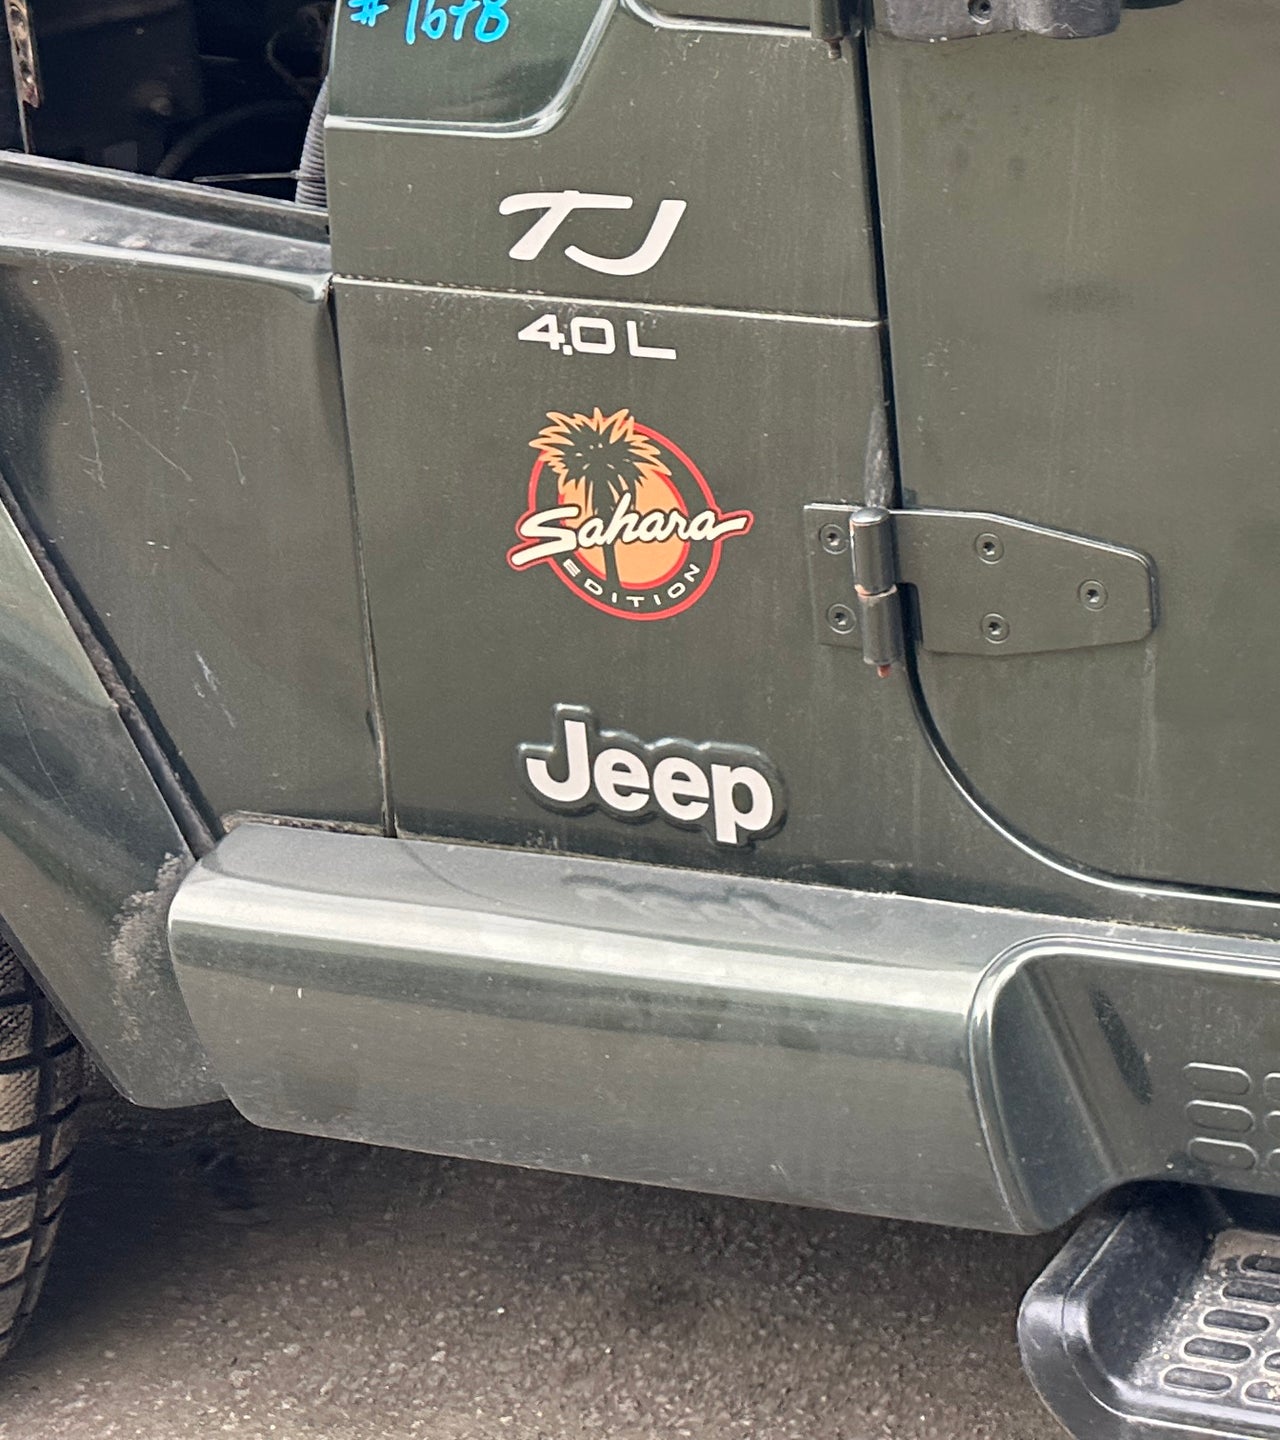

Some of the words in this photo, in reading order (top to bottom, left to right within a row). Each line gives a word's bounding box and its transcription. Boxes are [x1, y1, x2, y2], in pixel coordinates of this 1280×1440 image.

[499, 190, 687, 276] TJ
[510, 492, 748, 566] Sahara
[562, 558, 701, 608] EDITION
[525, 719, 774, 844] Jeep
